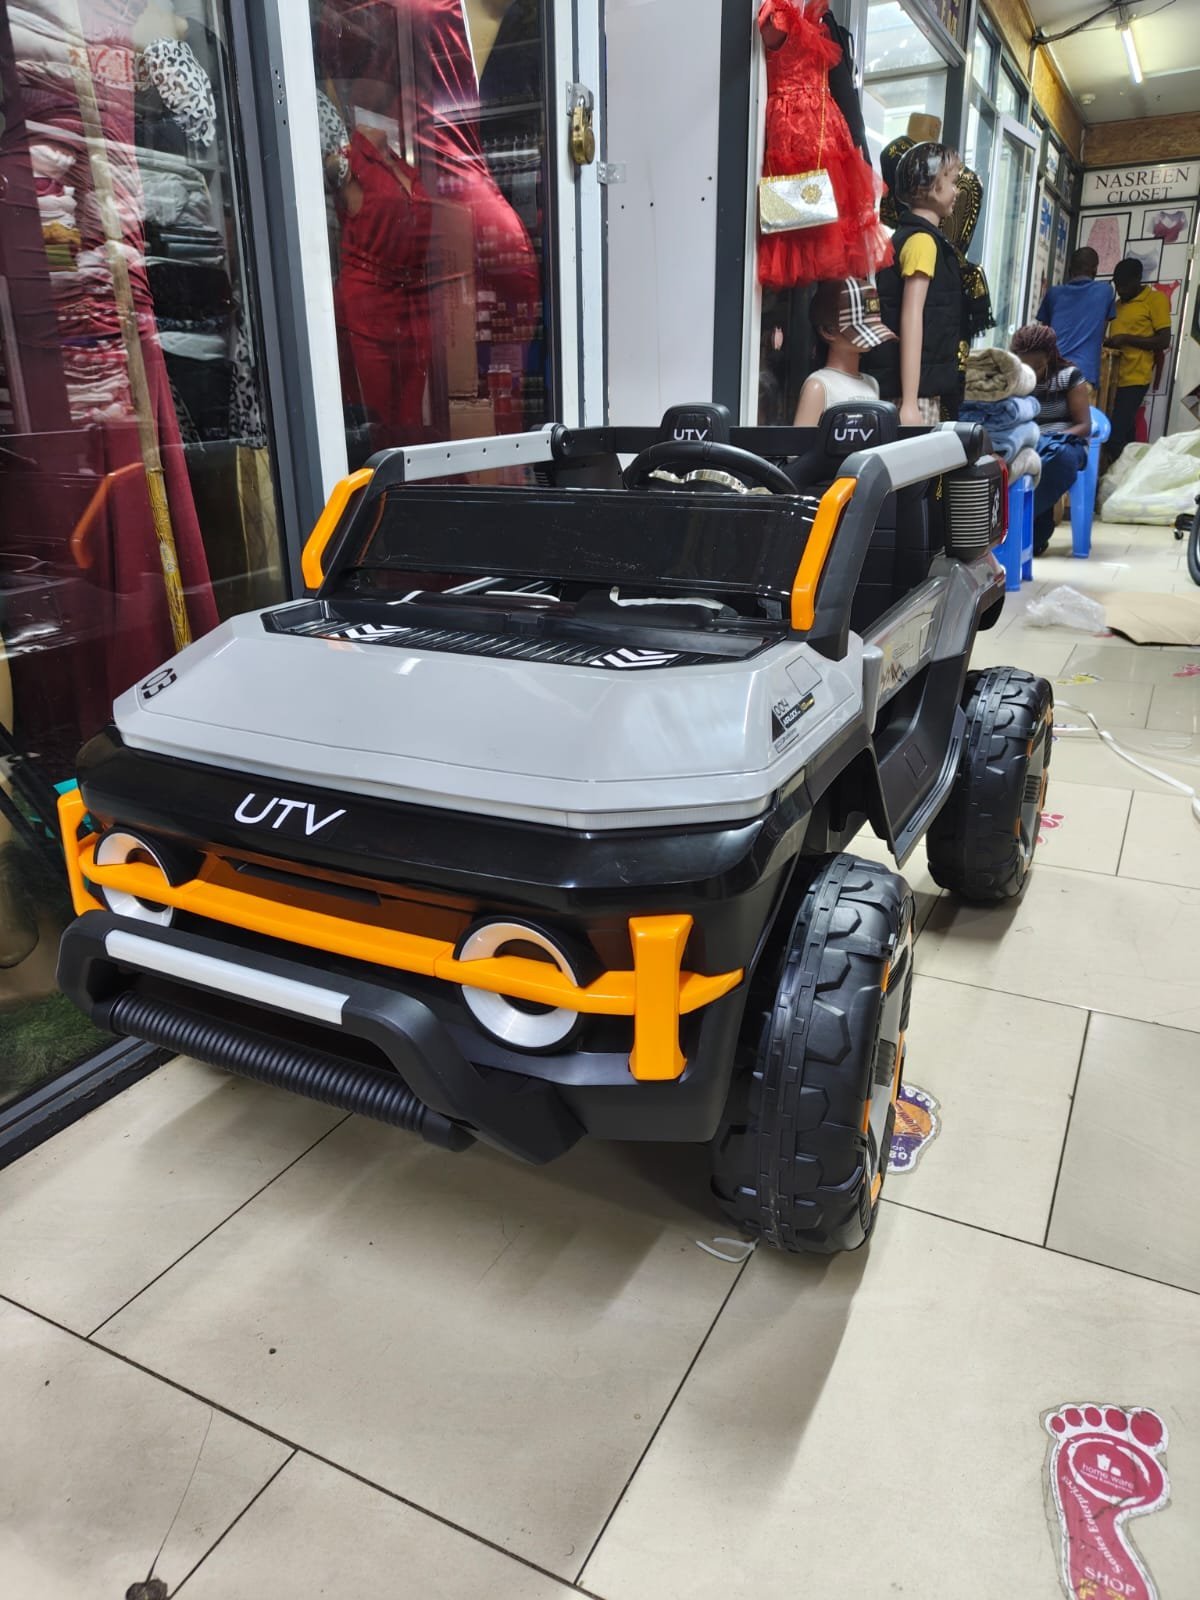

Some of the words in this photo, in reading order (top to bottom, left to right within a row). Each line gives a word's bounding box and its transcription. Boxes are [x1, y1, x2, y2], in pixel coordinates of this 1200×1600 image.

[1095, 167, 1191, 190] NASREEN
[1107, 187, 1173, 204] CLOSET
[673, 428, 708, 441] UTV
[834, 428, 875, 442] UTV
[234, 793, 347, 836] UTV
[1082, 1463, 1109, 1480] home
[1110, 1474, 1135, 1490] ware
[1083, 1566, 1137, 1597] SHOP
